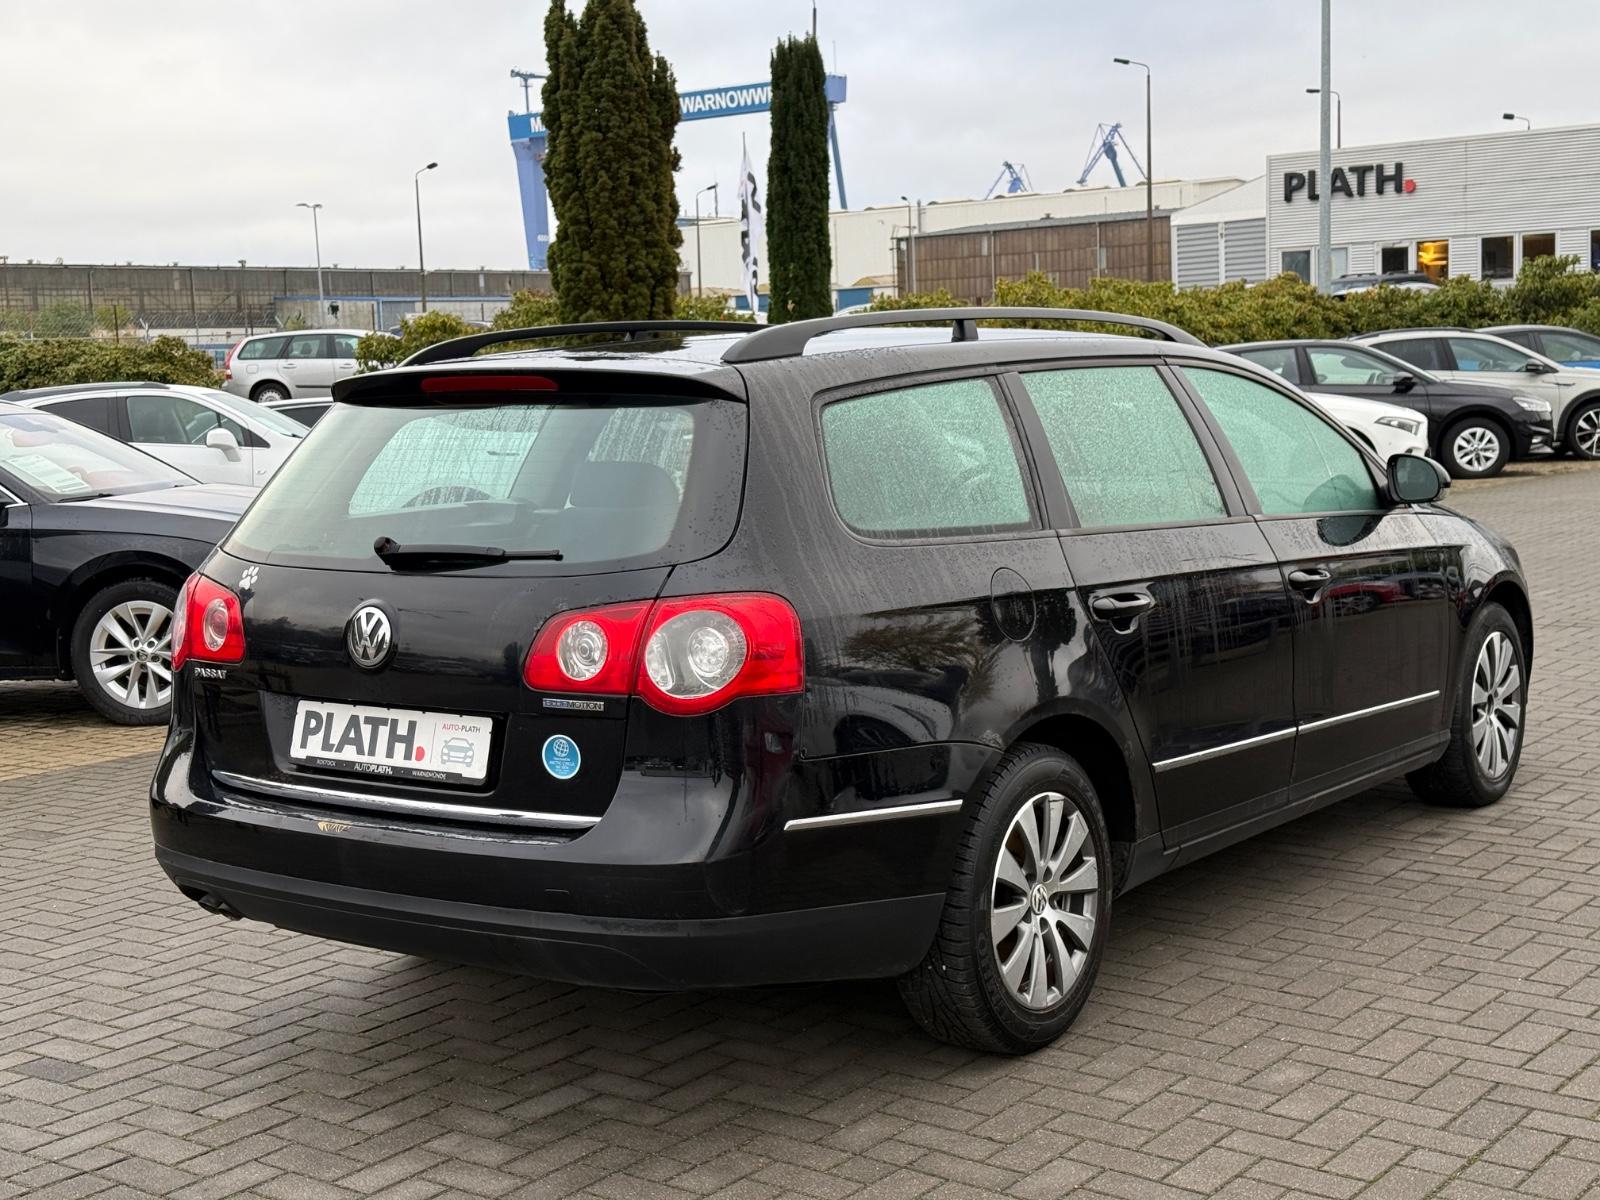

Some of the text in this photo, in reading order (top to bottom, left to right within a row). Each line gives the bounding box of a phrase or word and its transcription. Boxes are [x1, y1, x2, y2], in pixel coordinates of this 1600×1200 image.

[1284, 162, 1416, 203] PLATH.
[350, 606, 393, 668] VW
[194, 667, 227, 679] PASSAT
[299, 709, 426, 762] PLATH.
[442, 722, 481, 734] AUTO-PLATH
